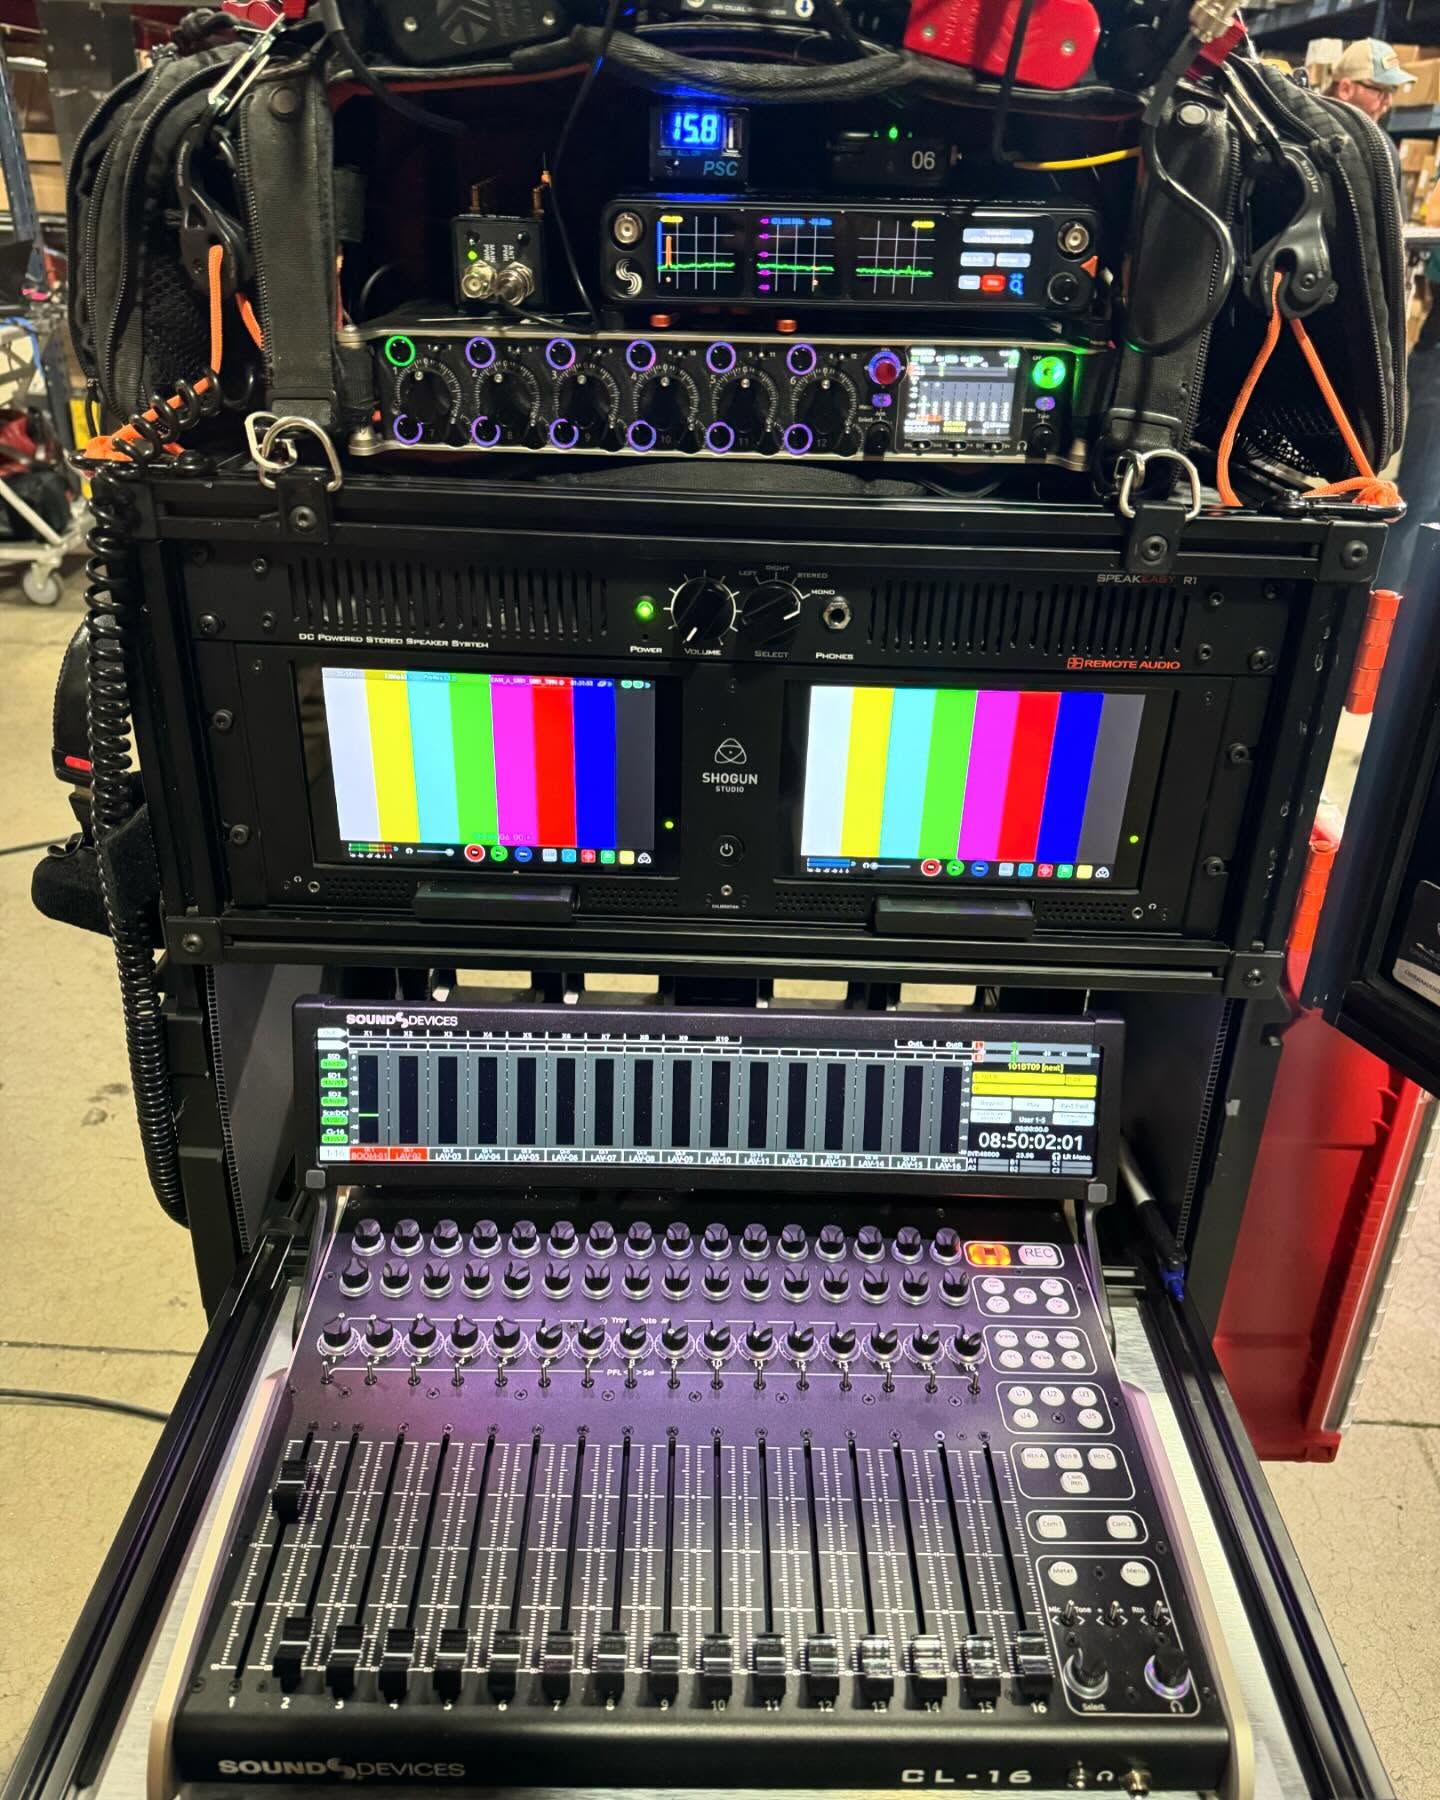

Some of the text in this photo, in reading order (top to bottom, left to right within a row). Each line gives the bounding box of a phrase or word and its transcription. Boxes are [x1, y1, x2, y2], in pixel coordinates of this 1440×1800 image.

[911, 150, 936, 170] 06
[703, 160, 738, 177] PSC
[392, 367, 398, 375] 1
[471, 368, 478, 377] 2
[551, 371, 558, 380] 3
[630, 372, 637, 381] 4
[709, 375, 717, 384] 5
[789, 376, 797, 385] 6
[429, 429, 435, 438] 7
[585, 433, 591, 442] 9
[660, 435, 671, 444] 10
[739, 437, 749, 446] 11
[817, 439, 827, 447] 12
[1097, 574, 1198, 585] SPEAKEASY R1
[299, 633, 315, 641] DC
[1084, 660, 1181, 670] REMOTE AUDIO
[702, 772, 759, 785] SHOGUN
[715, 785, 745, 793] STUDIO
[346, 1014, 458, 1027] SOUND DEVICES
[978, 1132, 1083, 1150] 08:50:02:01
[590, 1154, 616, 1162] LAV-07
[705, 1156, 732, 1164] LAV-10
[1024, 1247, 1054, 1258] REC
[331, 1356, 337, 1364] 1
[671, 1359, 678, 1367] 9
[838, 1361, 848, 1369] 13
[964, 1363, 975, 1371] 16
[607, 1368, 622, 1376] PFL
[228, 1696, 1047, 1714] 1 2 3 4 5 6 7 8 9 10 11 12 13 14 15 16
[1082, 1703, 1106, 1712] Select
[218, 1759, 466, 1777] SOUND DEVICES
[901, 1770, 1032, 1784] CL-16
